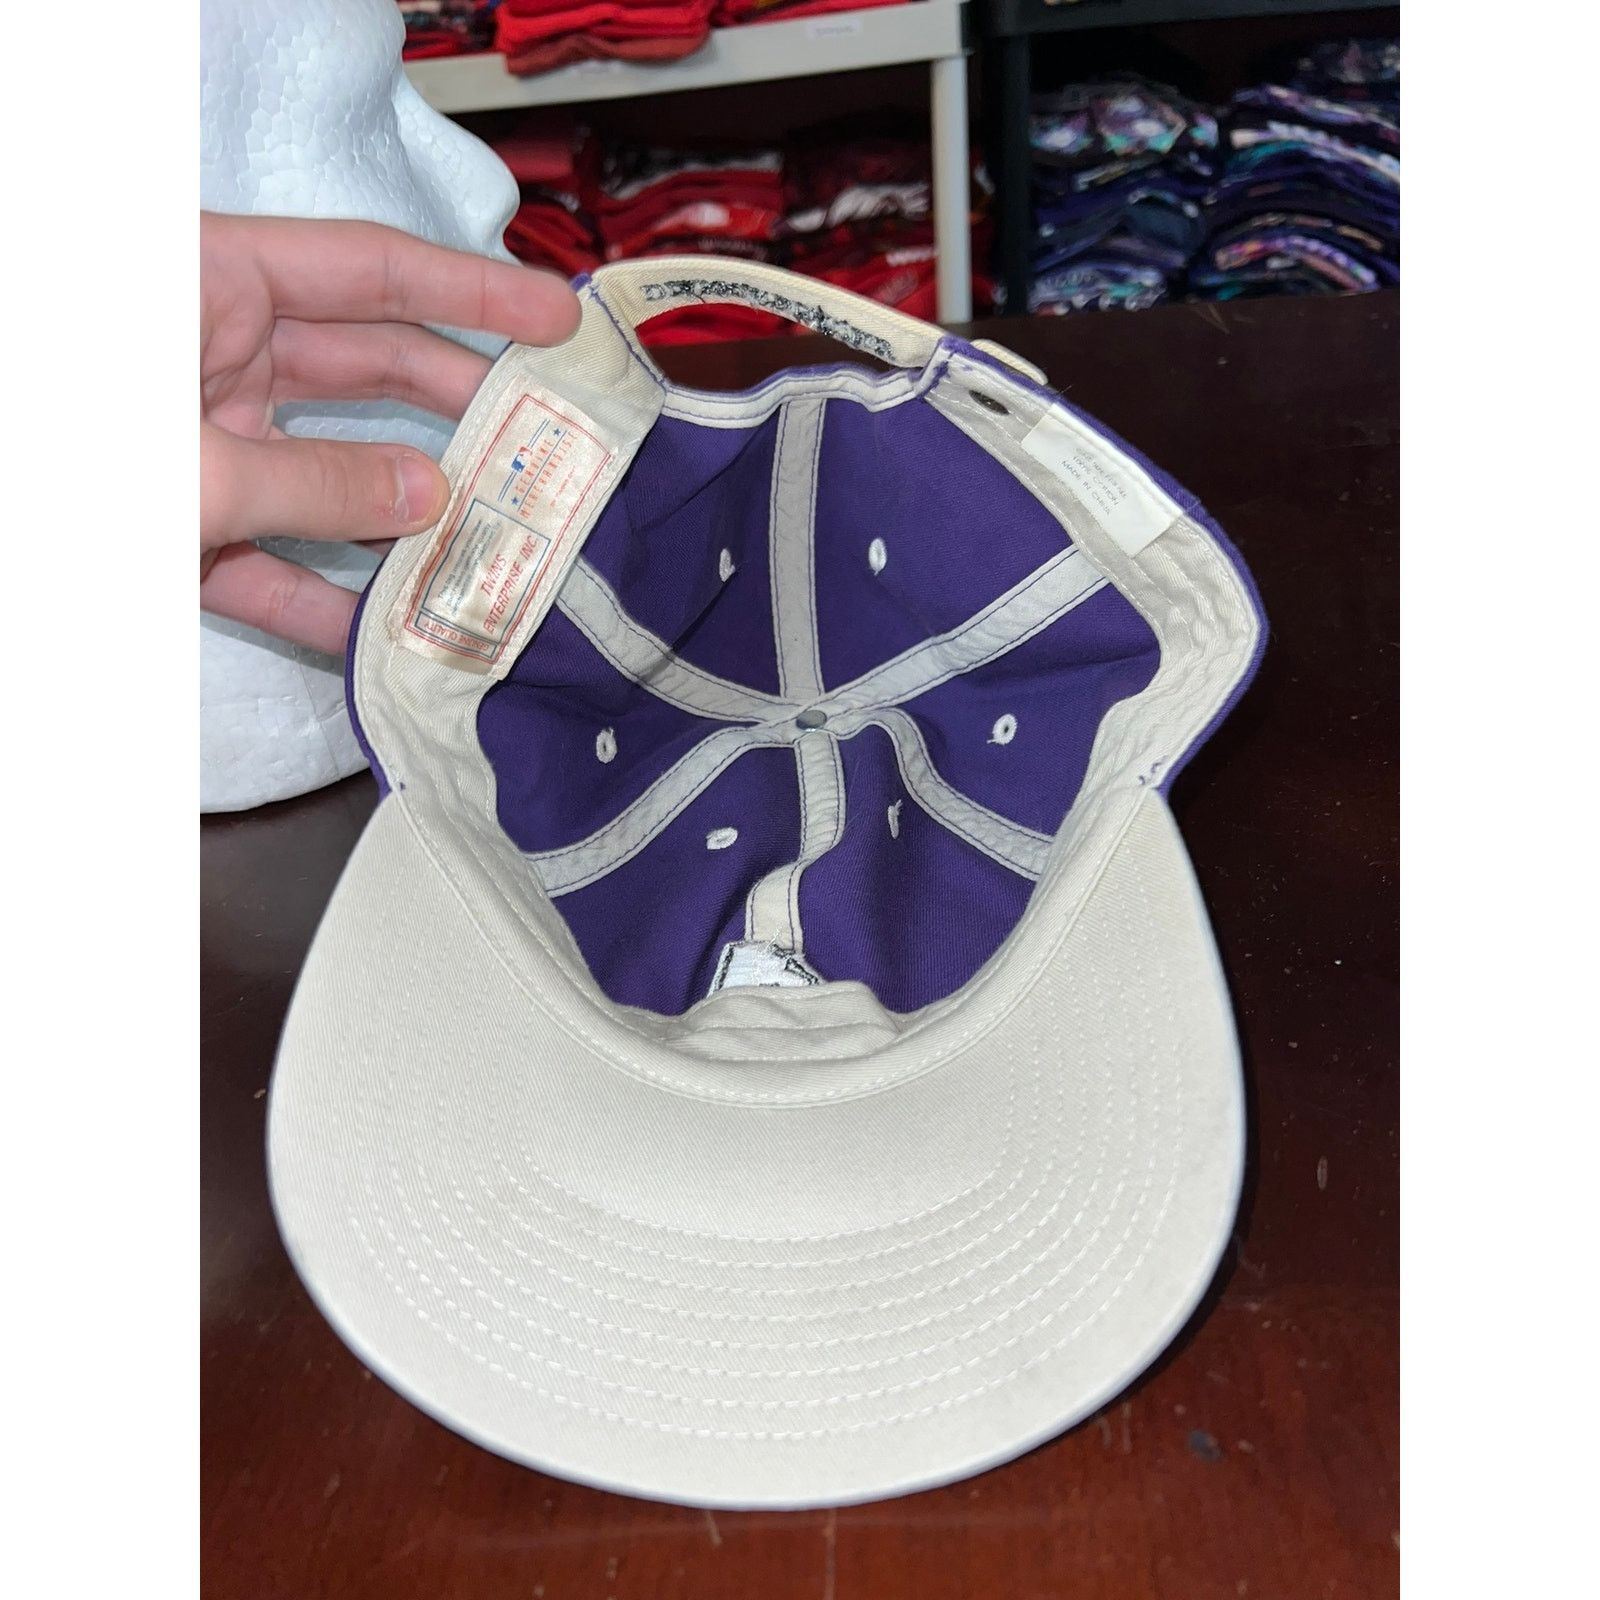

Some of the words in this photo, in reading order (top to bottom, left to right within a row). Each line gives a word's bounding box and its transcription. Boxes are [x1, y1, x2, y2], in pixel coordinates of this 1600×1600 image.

[479, 552, 508, 596] TWINS
[482, 560, 524, 634] ENTERPRISE
[423, 621, 458, 641] QUALITY
